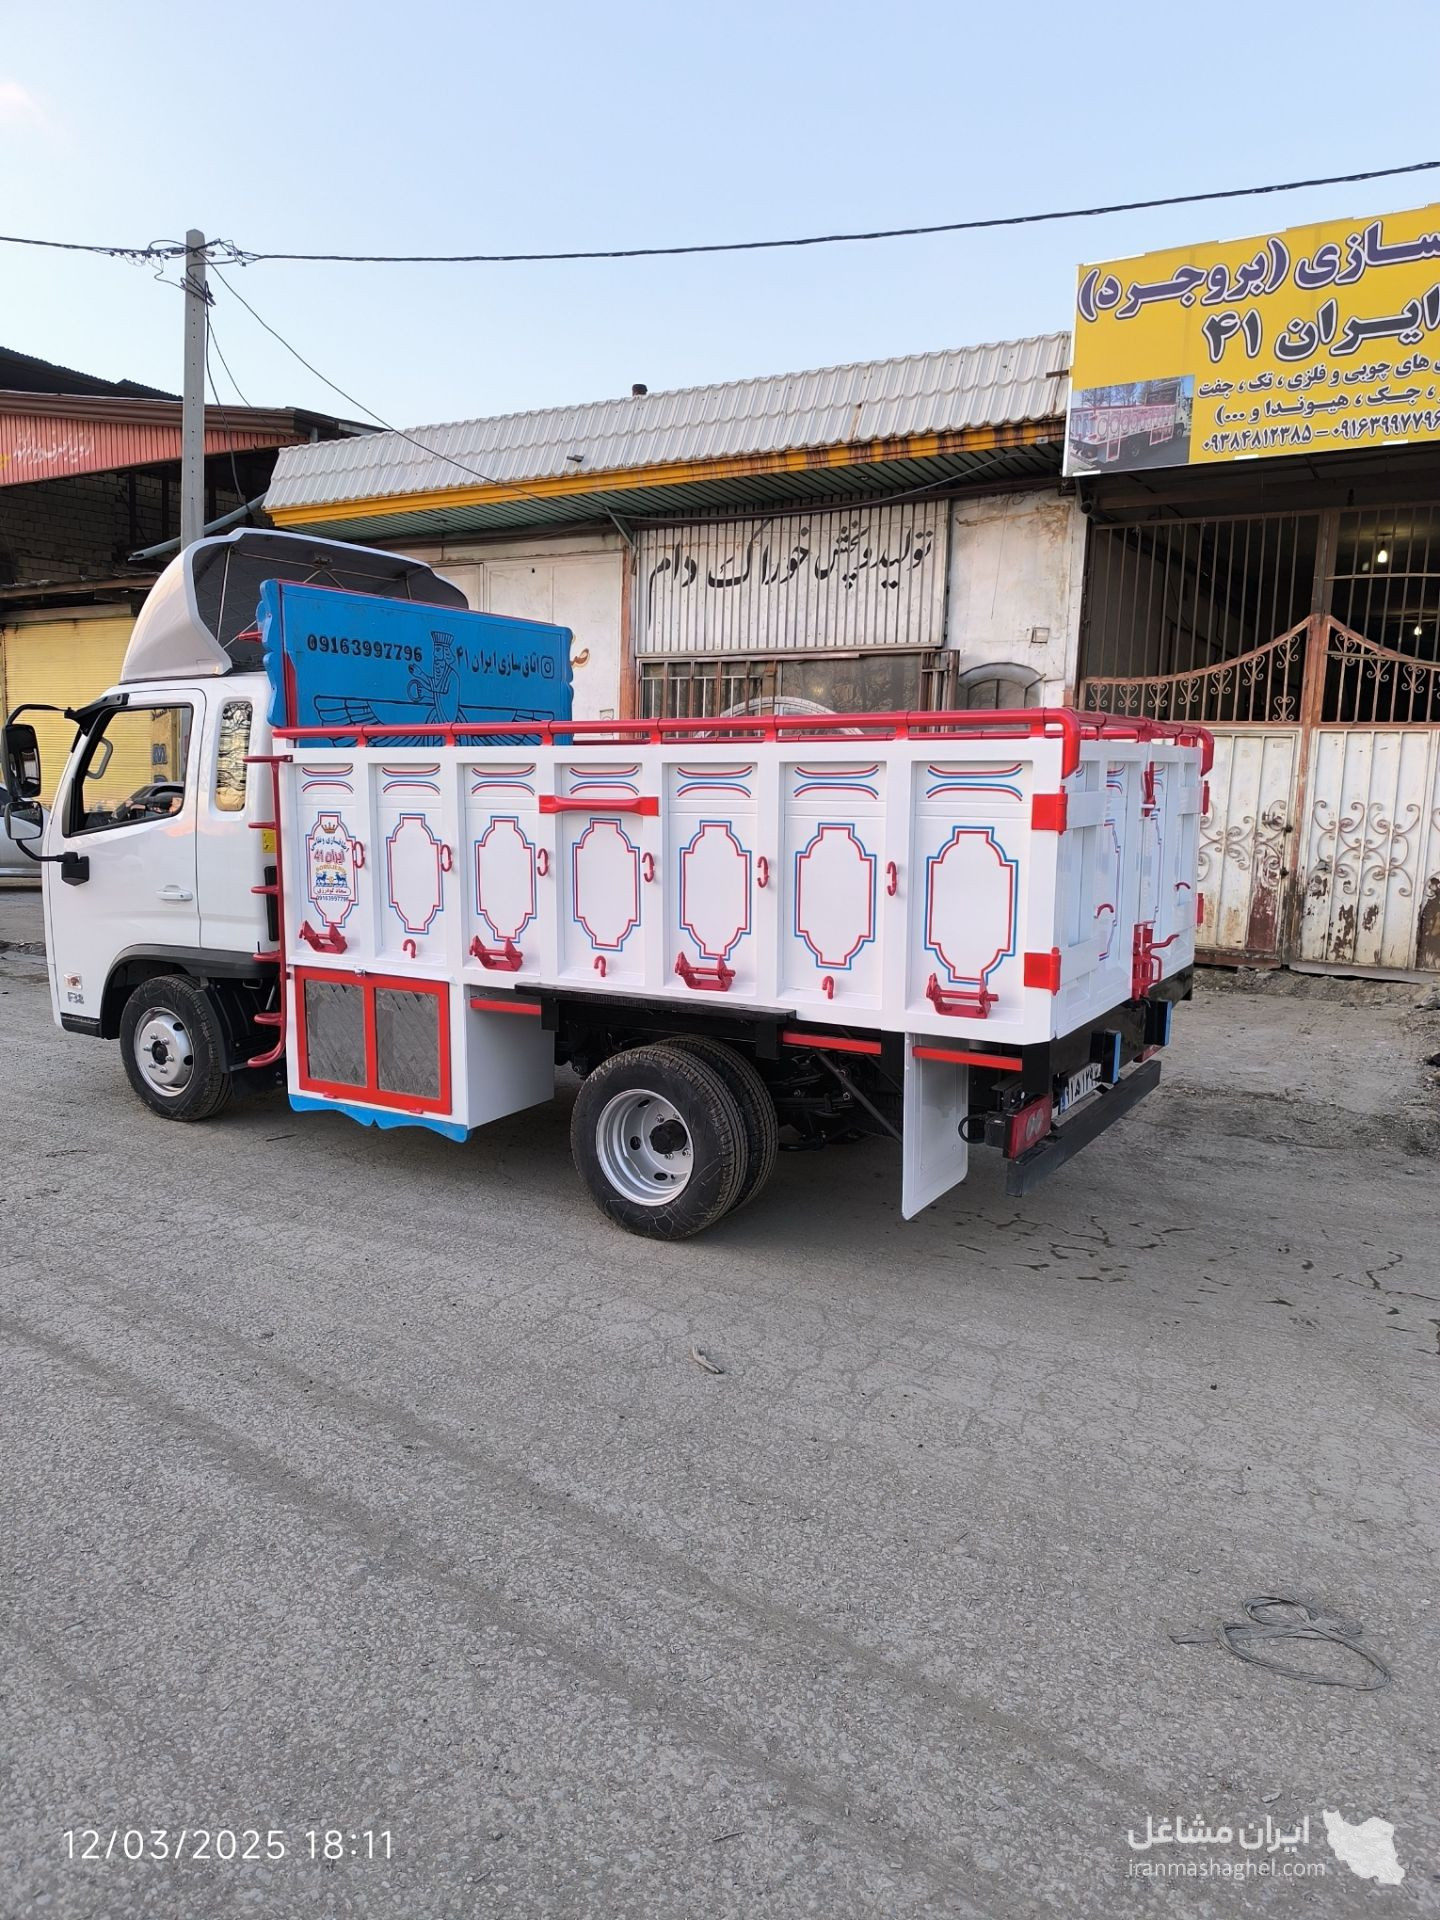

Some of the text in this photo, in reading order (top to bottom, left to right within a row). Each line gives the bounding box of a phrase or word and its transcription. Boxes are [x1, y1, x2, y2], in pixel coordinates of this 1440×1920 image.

[1078, 236, 1290, 322] (بروجرد)
[1201, 283, 1440, 363] ایران ۴۱
[1328, 368, 1341, 387] و
[1343, 361, 1392, 384] چوبی
[1394, 352, 1431, 377] های
[1264, 394, 1350, 417] هیوندا
[707, 518, 810, 588] خوراک
[870, 526, 934, 589] تولید
[648, 540, 697, 630] دام
[307, 633, 423, 663] 09163997796
[472, 648, 497, 674] ایران
